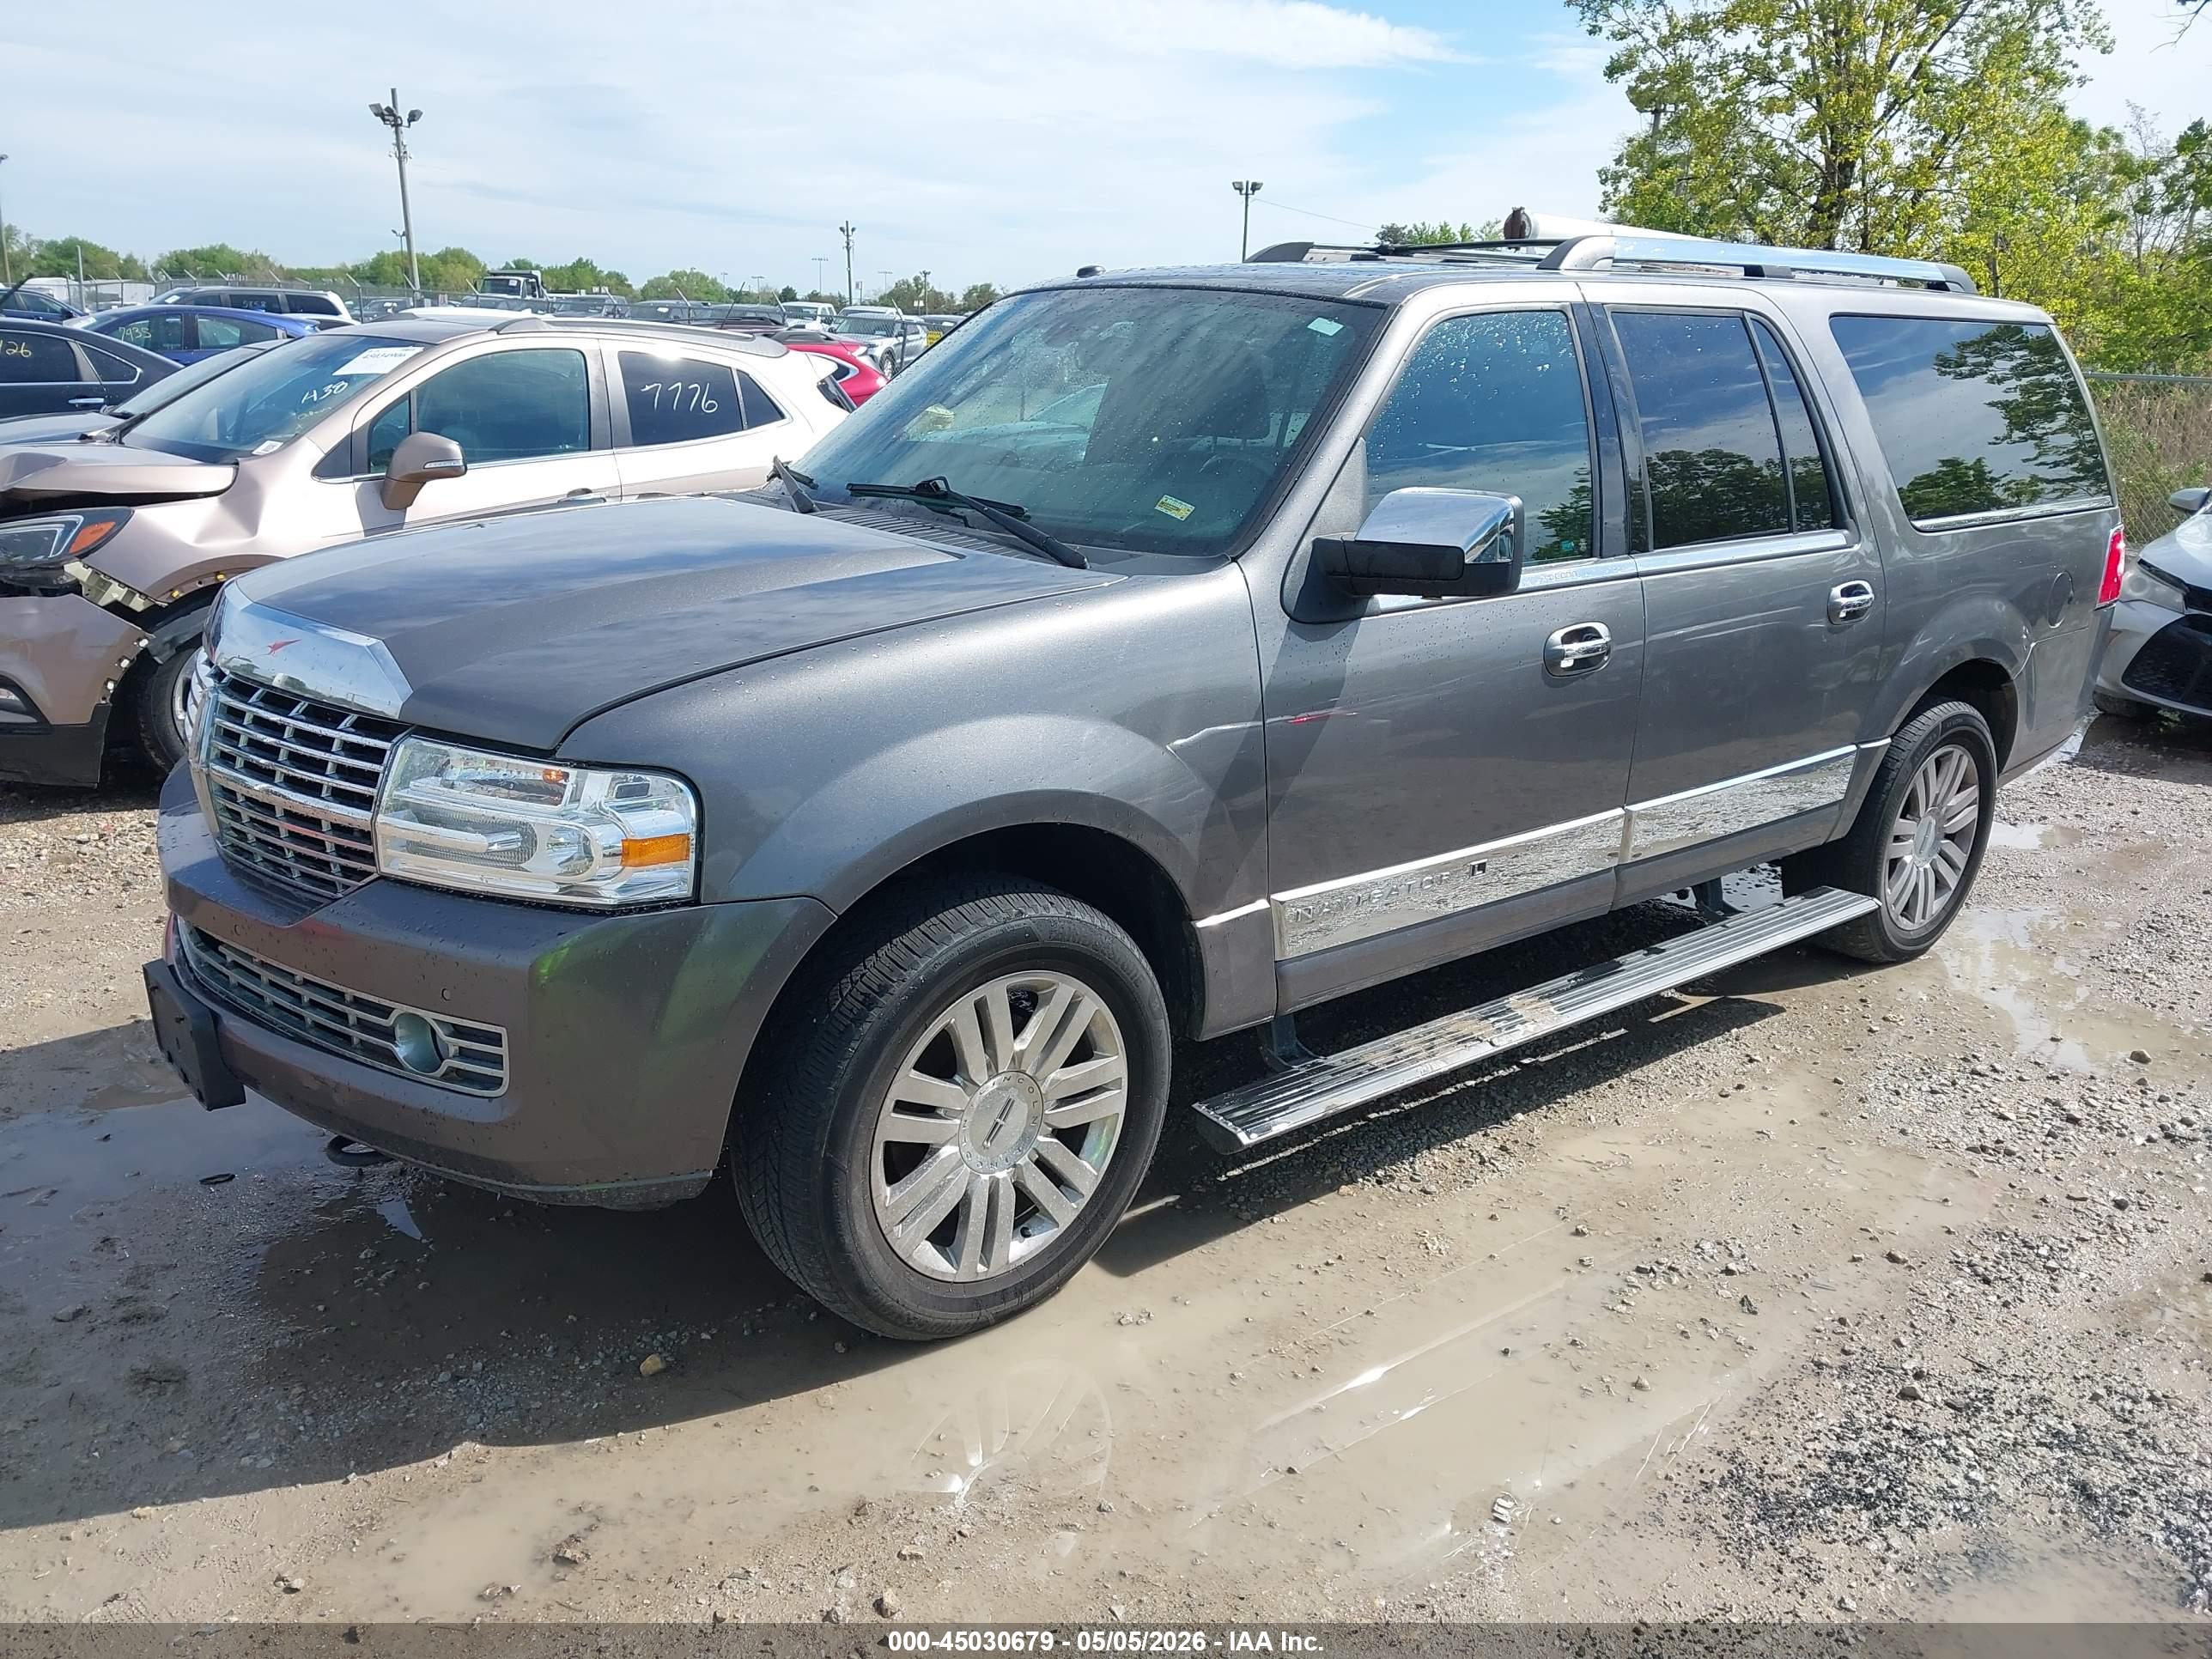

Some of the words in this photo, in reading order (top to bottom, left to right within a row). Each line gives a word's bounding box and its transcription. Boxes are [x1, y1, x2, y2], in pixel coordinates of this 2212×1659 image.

[641, 382, 718, 413] 7776
[1295, 871, 1451, 923] NAVIGATOR
[978, 1075, 1039, 1127] LINCOLN
